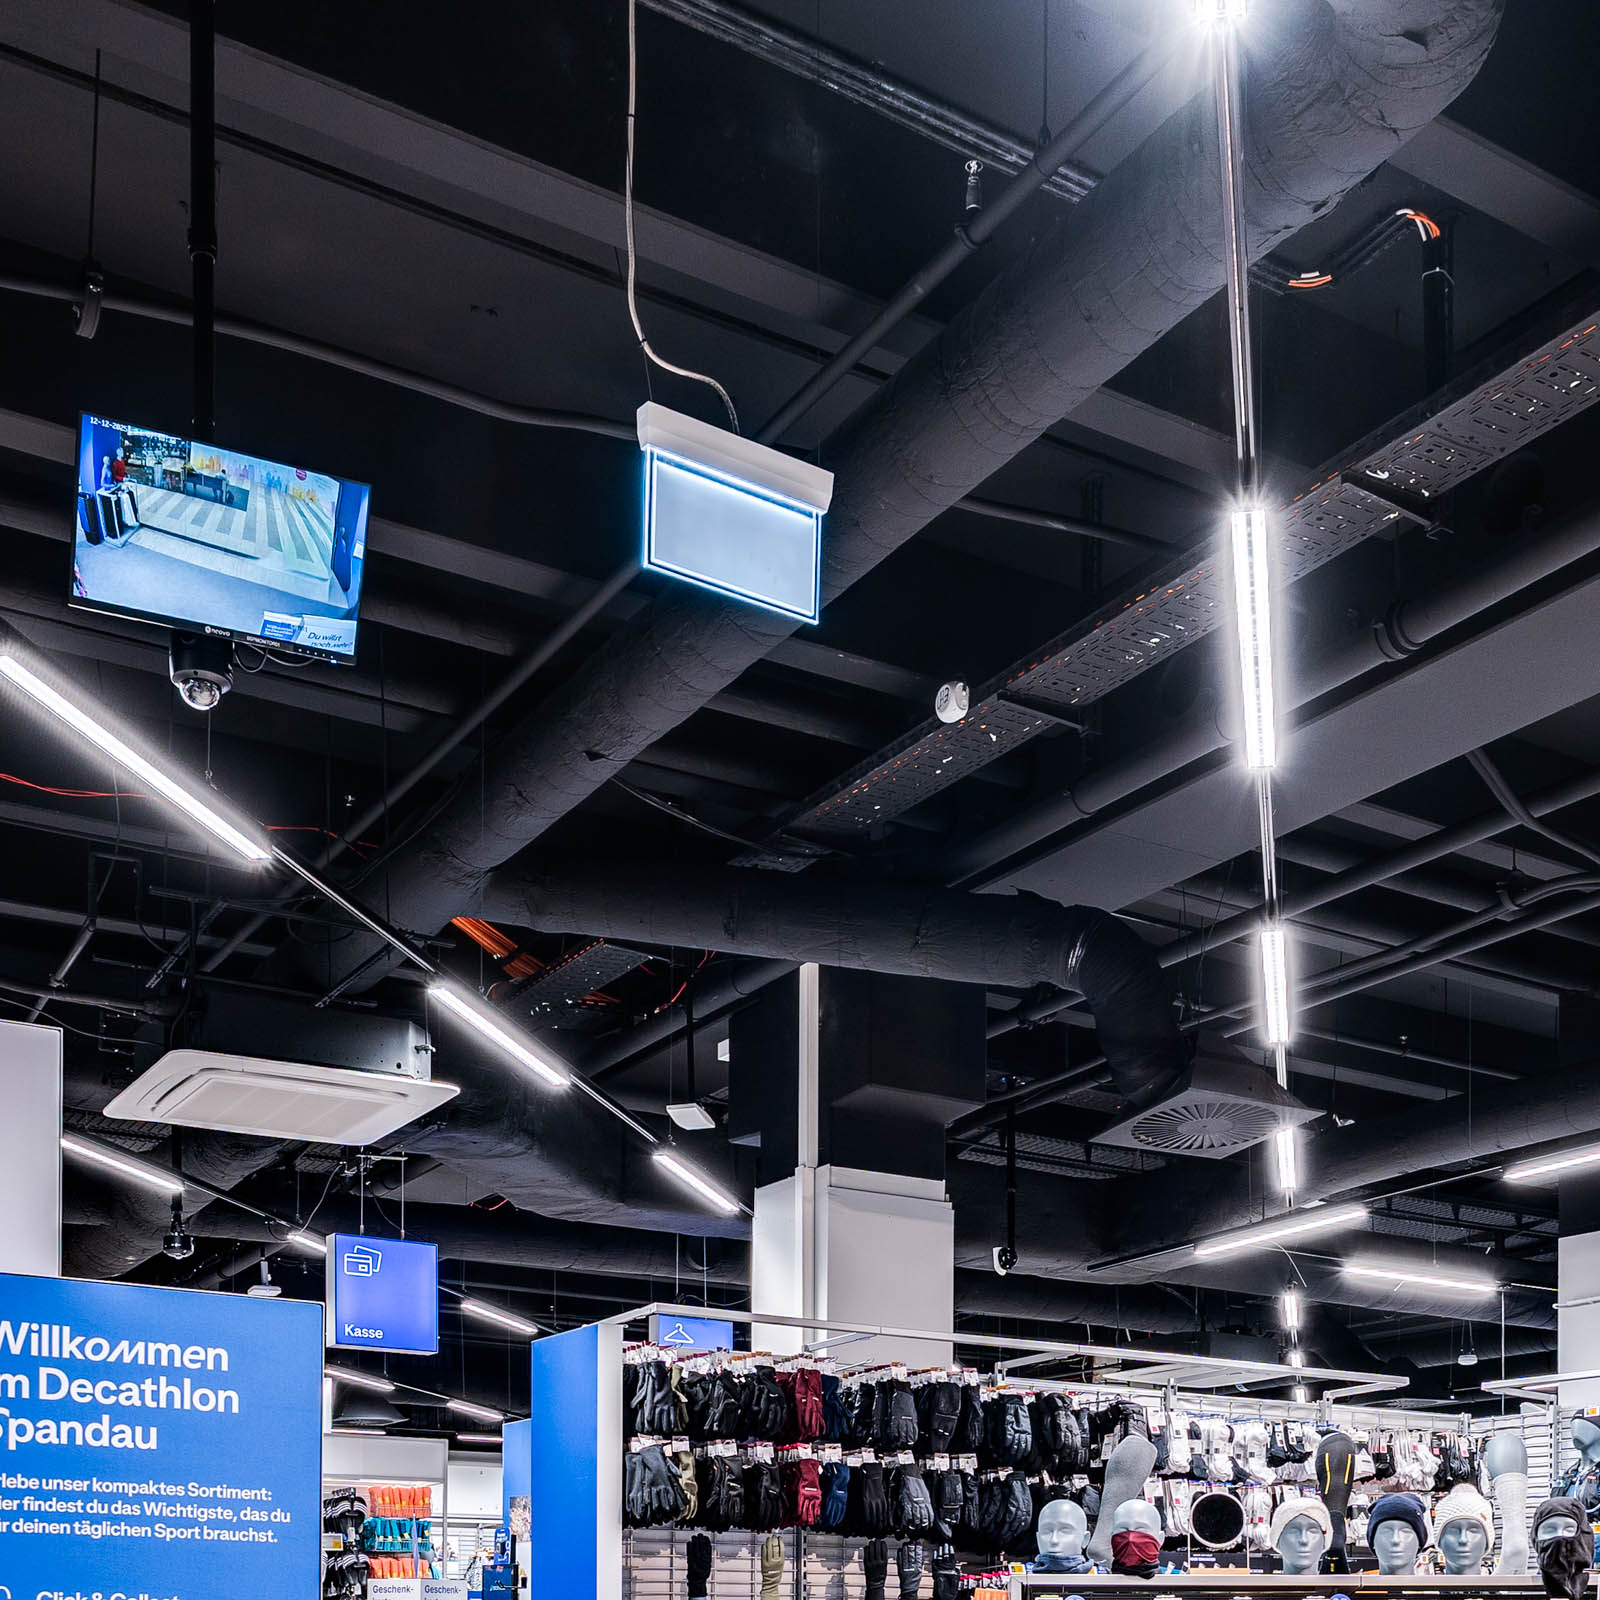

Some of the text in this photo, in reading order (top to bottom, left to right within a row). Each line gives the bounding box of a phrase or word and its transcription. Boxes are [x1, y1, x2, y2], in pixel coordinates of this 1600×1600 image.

[344, 1323, 384, 1340] Kasse
[38, 1366, 240, 1414] Decathlon
[41, 1478, 91, 1492] unser
[92, 1477, 186, 1497] kompaktes
[187, 1481, 273, 1501] Sortiment:
[21, 1495, 84, 1513] findest
[85, 1498, 109, 1514] du
[110, 1500, 141, 1516] das
[142, 1500, 238, 1523] Wichtigste,
[239, 1506, 269, 1522] das
[269, 1507, 291, 1523] du
[11, 1517, 71, 1535] deinen
[72, 1519, 152, 1539] täglichen
[153, 1523, 201, 1542] Sport
[202, 1525, 278, 1543] brauchst.
[372, 1584, 414, 1594] Geschenk-
[424, 1584, 462, 1594] Geschenk-
